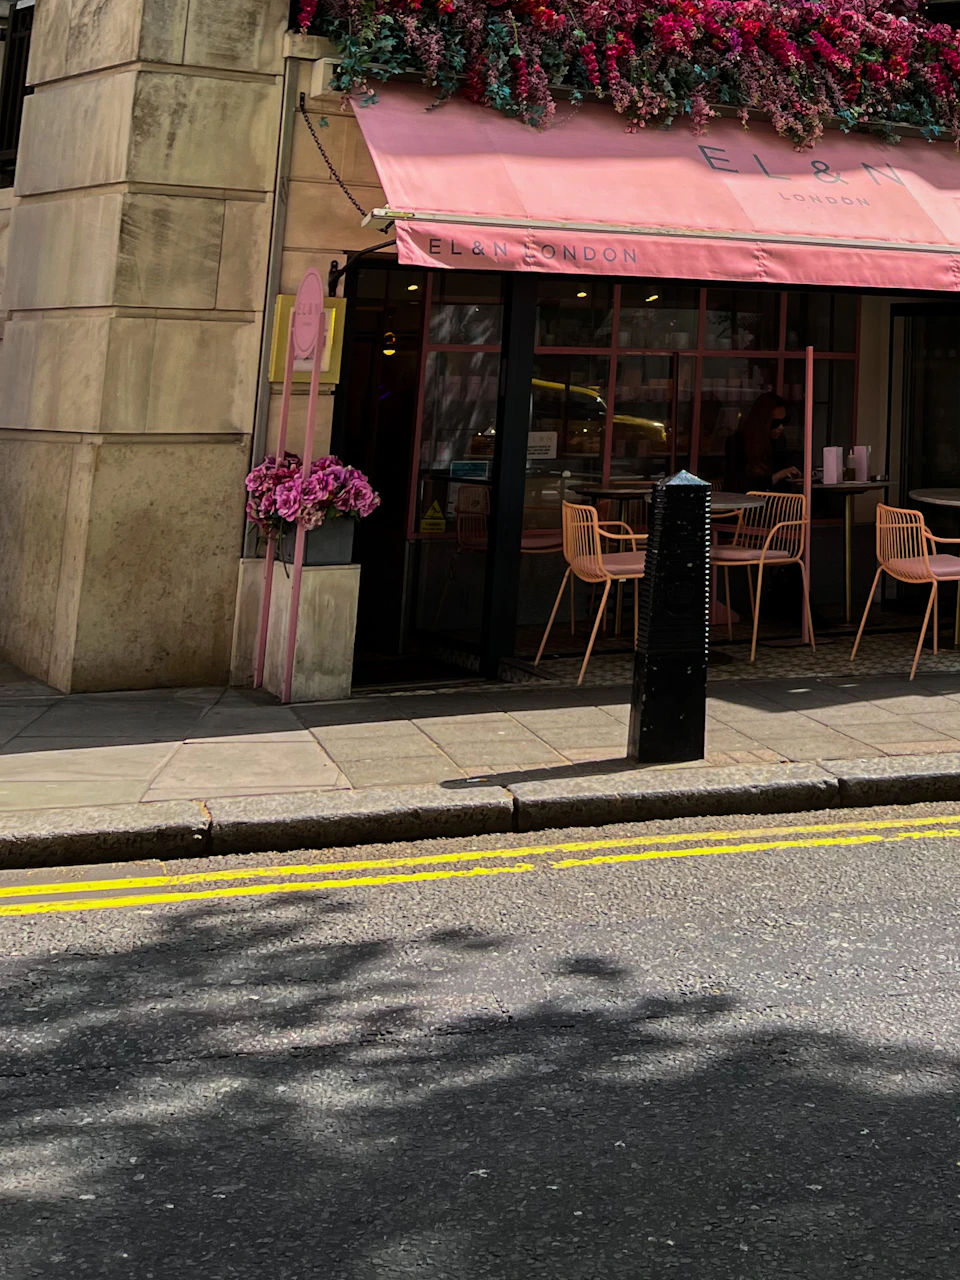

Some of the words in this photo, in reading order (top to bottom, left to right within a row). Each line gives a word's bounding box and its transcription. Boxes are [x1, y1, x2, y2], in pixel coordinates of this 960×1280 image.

[778, 191, 871, 207] LONDON
[429, 238, 508, 258] EL&N
[523, 242, 637, 264] LONDON
